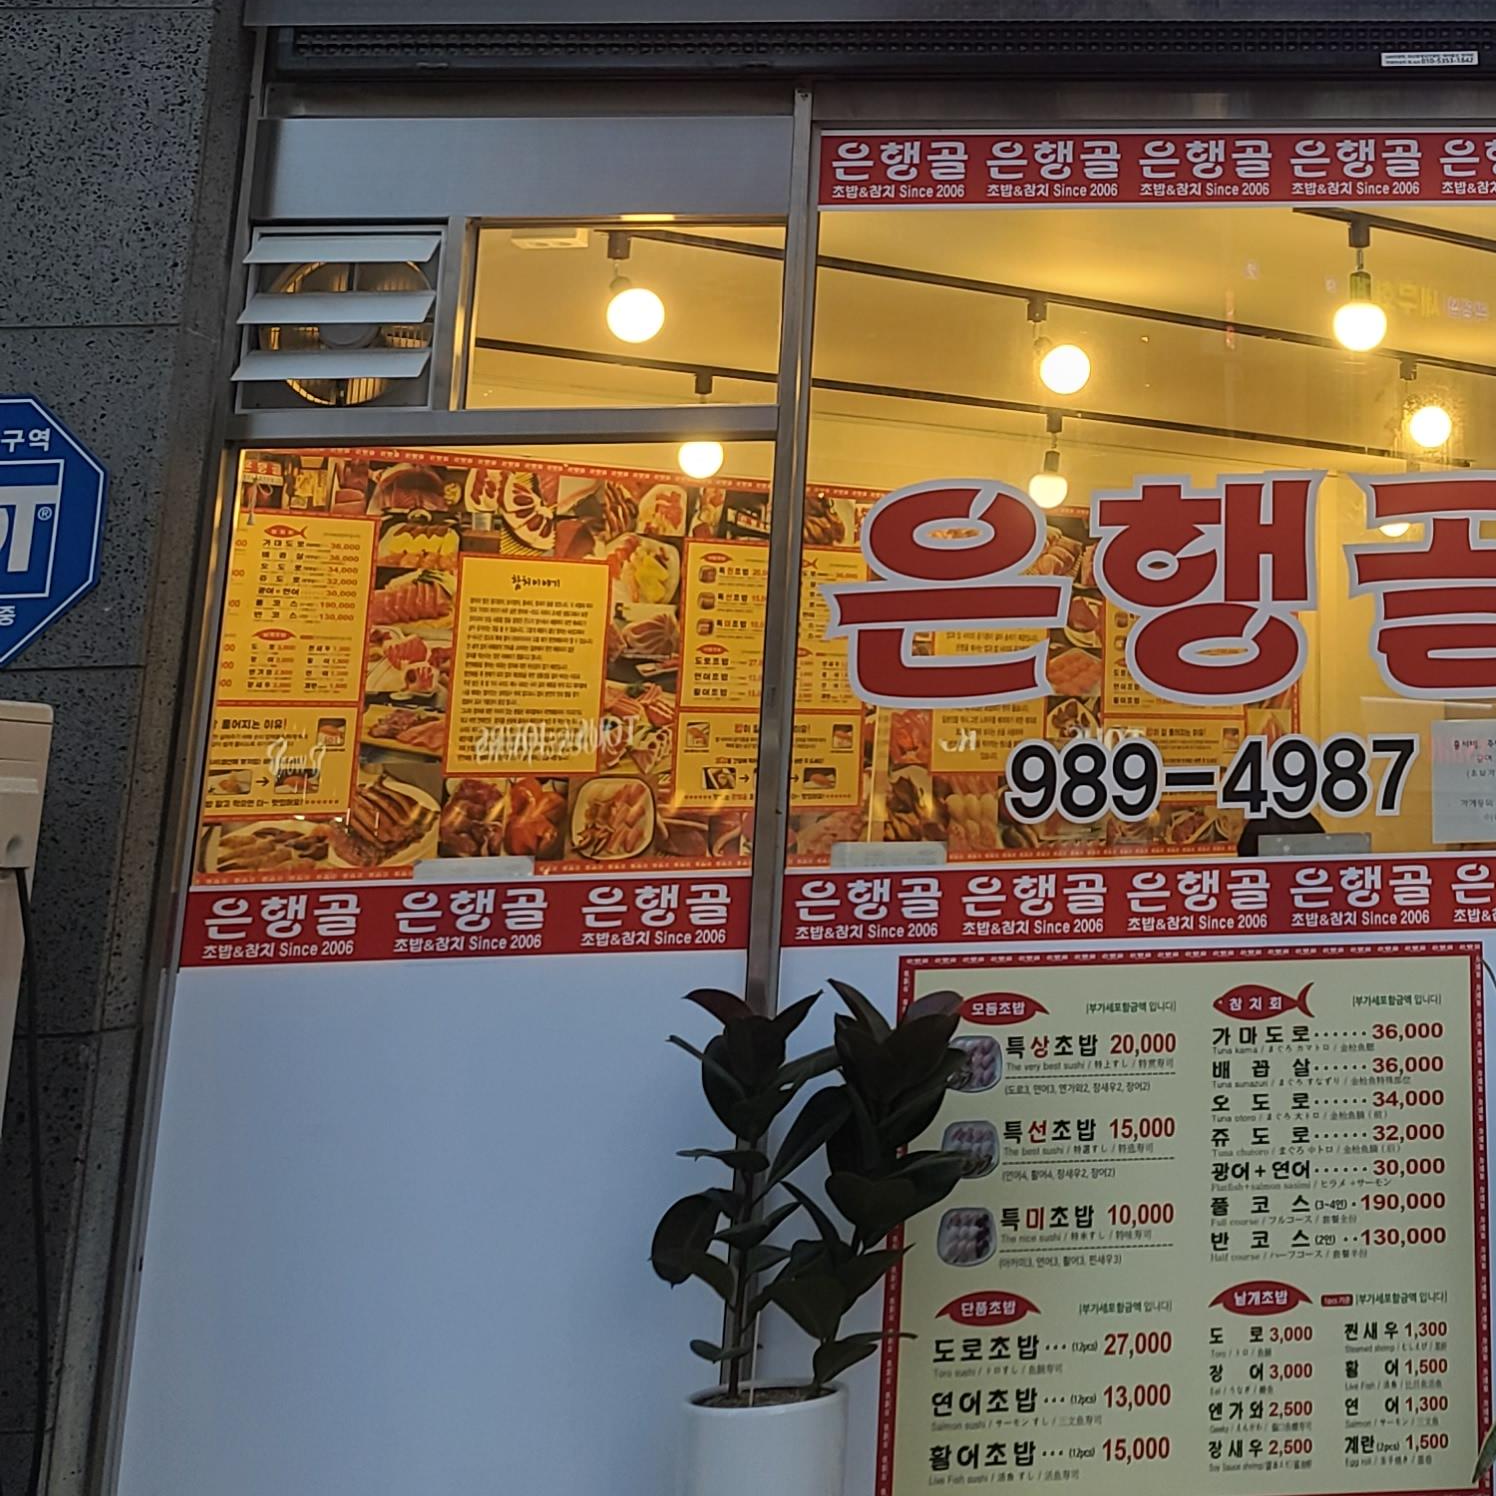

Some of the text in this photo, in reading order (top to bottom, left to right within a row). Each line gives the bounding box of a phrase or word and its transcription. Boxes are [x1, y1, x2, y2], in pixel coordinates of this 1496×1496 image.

[832, 141, 968, 181] 은행골
[987, 140, 1121, 180] 은행골
[1138, 139, 1272, 179] 은행골
[1289, 139, 1422, 178] 은행골
[900, 184, 933, 198] Since
[937, 184, 964, 198] 2006
[1054, 183, 1086, 197] Since
[1090, 183, 1117, 197] 2006
[1206, 182, 1239, 195] Since
[1242, 182, 1269, 195] 2006
[1357, 182, 1389, 195] Since
[1392, 180, 1419, 194] 2006
[1006, 734, 1416, 824] 989-4987
[962, 873, 1107, 917] 은행골
[1127, 869, 1270, 913] 은행골
[1290, 865, 1432, 908] 은행골
[581, 883, 731, 928] 은행골
[796, 877, 942, 921] 은행골
[205, 894, 361, 940] 은행골
[396, 888, 548, 933] 은행골
[1362, 910, 1397, 926] Since
[1400, 909, 1429, 925] 2006
[867, 924, 905, 939] Since
[907, 922, 938, 938] 2006
[1033, 919, 1070, 935] Since
[1073, 918, 1104, 934] 2006
[1198, 915, 1235, 930] Since
[1238, 913, 1268, 929] 2006
[468, 935, 508, 950] Since
[510, 933, 541, 949] 2006
[653, 930, 695, 945] Since
[697, 928, 727, 944] 2006
[278, 942, 319, 957] Since
[321, 939, 354, 956] 2006
[1213, 1023, 1443, 1045] 가마도로 36,000
[1006, 1033, 1176, 1059] 특상초밥 20,000
[1213, 1056, 1443, 1079] 배꼽살 36,000
[1212, 1090, 1444, 1111] 오도로 34,000
[1003, 1118, 1174, 1144] 특선초밥 15,000
[1373, 1124, 1444, 1143] 32,000
[1212, 1162, 1249, 1181] 광어
[1272, 1160, 1309, 1179] 연어
[1374, 1158, 1445, 1177] 30,000
[1361, 1193, 1445, 1212] 190,000
[1000, 1203, 1173, 1231] 특미초밥 10,000
[1211, 1230, 1310, 1251] 반코스
[1361, 1227, 1446, 1247] 130,000
[1209, 1326, 1312, 1344] 도로 3,000
[1405, 1322, 1447, 1339] 1,300
[933, 1335, 1039, 1363] 도로초밥
[1104, 1332, 1171, 1358] 27,000
[1210, 1363, 1312, 1383] 장어 3,000
[1405, 1359, 1447, 1376] 1,500
[932, 1388, 1037, 1417] 연어초밥
[1104, 1384, 1170, 1411] 13,000
[1269, 1401, 1312, 1418] 2,500
[1345, 1396, 1448, 1416] 연어 1,300
[929, 1441, 1036, 1471] 활어초밥
[1103, 1437, 1169, 1464] 15,000
[1269, 1439, 1312, 1456] 2,500
[1345, 1435, 1374, 1454] 계란
[1406, 1434, 1448, 1452] 1,500
